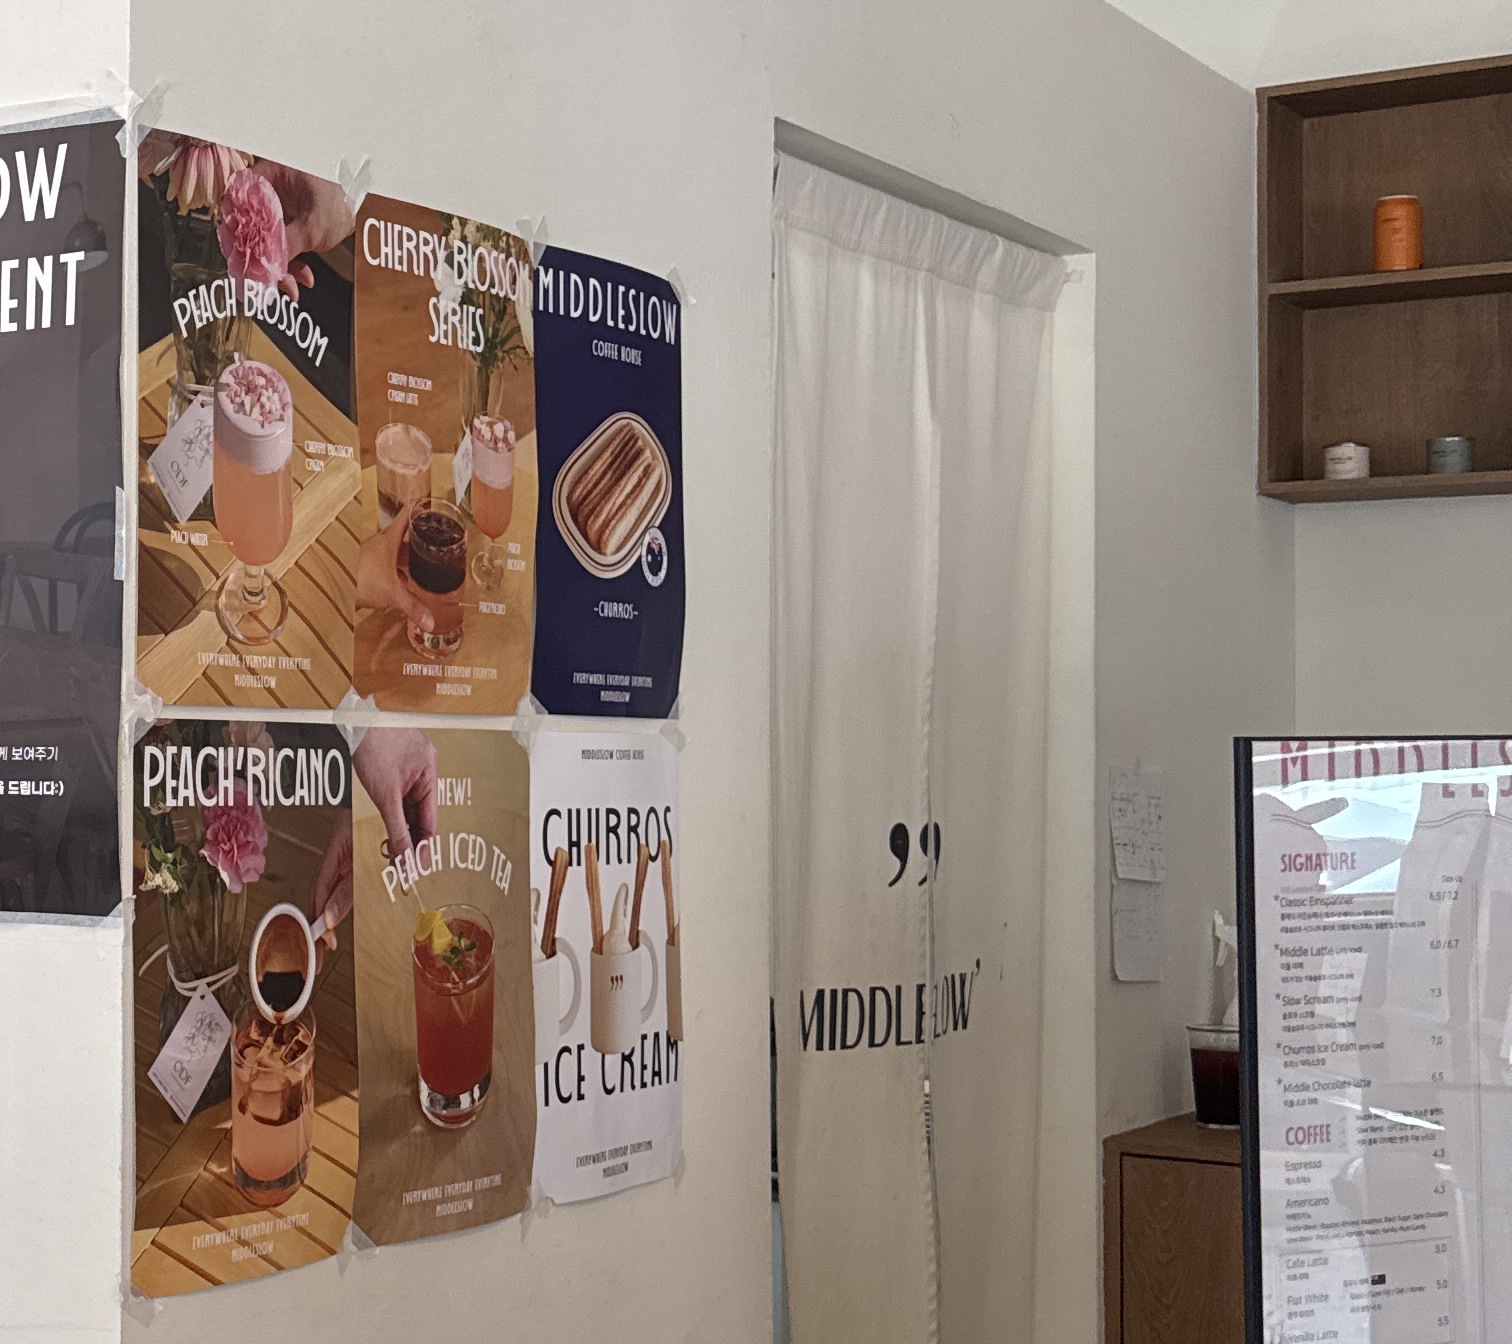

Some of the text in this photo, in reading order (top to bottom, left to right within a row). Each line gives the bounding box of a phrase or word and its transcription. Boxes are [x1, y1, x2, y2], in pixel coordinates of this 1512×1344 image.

[363, 217, 533, 301] CHERRY BLOSSOM
[173, 275, 329, 368] PEACH BLOSSOM
[428, 296, 484, 354] SERIES
[538, 265, 677, 346] MIDDLESLOW
[591, 339, 619, 361] COFFEE
[11, 746, 59, 762] 보여주기
[437, 777, 472, 805] NEW!
[542, 805, 673, 868] CHURROS
[1280, 851, 1357, 873] SIGNATURE
[381, 832, 513, 903] PEACH ICED TEA
[543, 1042, 586, 1107] ICE
[1285, 1123, 1332, 1146] COFFEE
